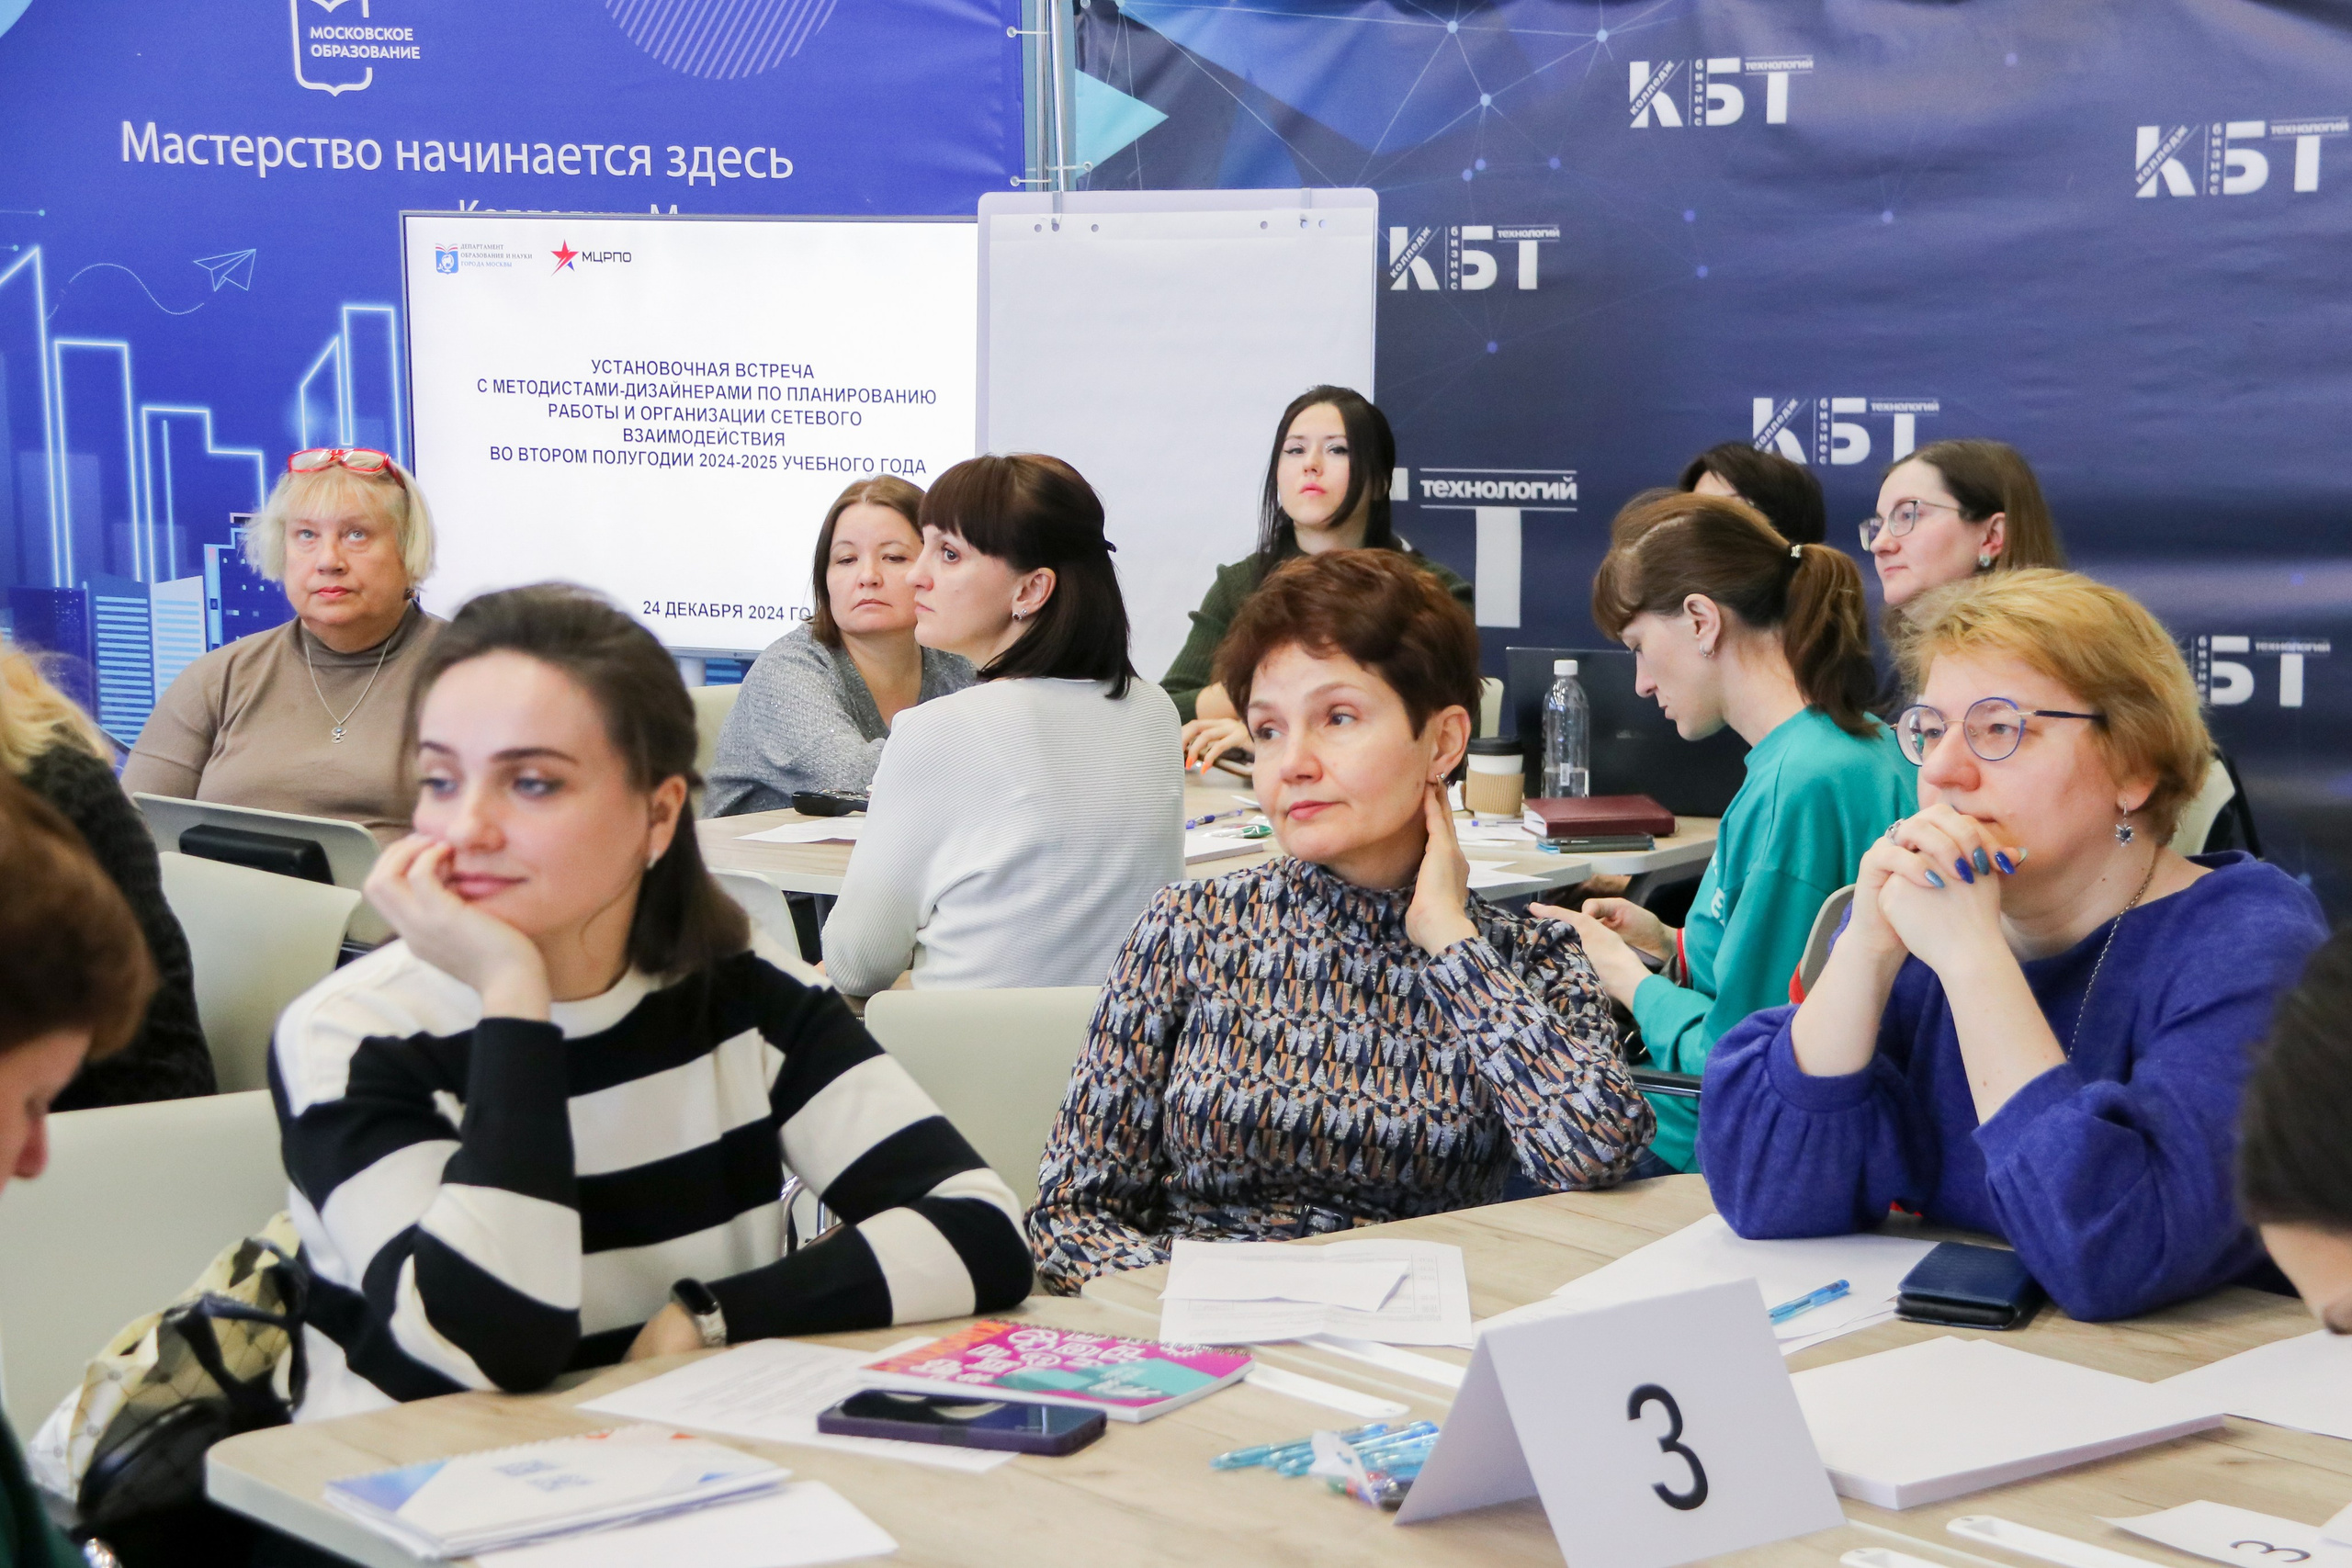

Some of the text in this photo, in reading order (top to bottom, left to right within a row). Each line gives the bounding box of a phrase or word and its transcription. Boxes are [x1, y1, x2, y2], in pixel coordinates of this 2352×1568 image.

[311, 27, 413, 40] МОСКОВСКОЕ
[311, 44, 421, 59] ОБРАЗОВАНИЕ
[1745, 57, 1814, 71] технологий
[1629, 61, 1675, 116] колледж
[1694, 59, 1703, 126] бизнес
[122, 120, 794, 186] Мастерство начинается здесь
[2135, 124, 2188, 185] колледж
[2209, 122, 2222, 196] бизнес
[1497, 227, 1561, 239] технологий
[582, 251, 632, 263] МЦРПО
[1389, 226, 1431, 278] колледж
[1450, 226, 1459, 290] бизнес
[591, 359, 815, 378] УСТАНОВОЧНАЯ ВСТРЕЧА
[477, 378, 936, 405] С МЕТОДИСТАМИ-ДИЗАЙНЕРАМИ ПО ПЛАНИРОВАНИЮ
[548, 403, 863, 426] РАБОТЫ И ОРГАНИЗАЦИИ СЕТЕВОГО
[623, 427, 786, 447] ВЗАИМОДЕЙСТВИЯ
[1818, 398, 1828, 465] бизнес
[490, 446, 927, 476] ВО ВТОРОМ ПОЛУГОДИИ 2024-2025 УЧЕБНОГО ГОДА
[1419, 476, 1577, 501] технологий
[643, 600, 812, 622] 24 ДЕКАБРЯ 2024 ГО
[2210, 636, 2304, 707] БТ
[1627, 1382, 1708, 1511] 3
[2229, 1540, 2312, 1562] 3
